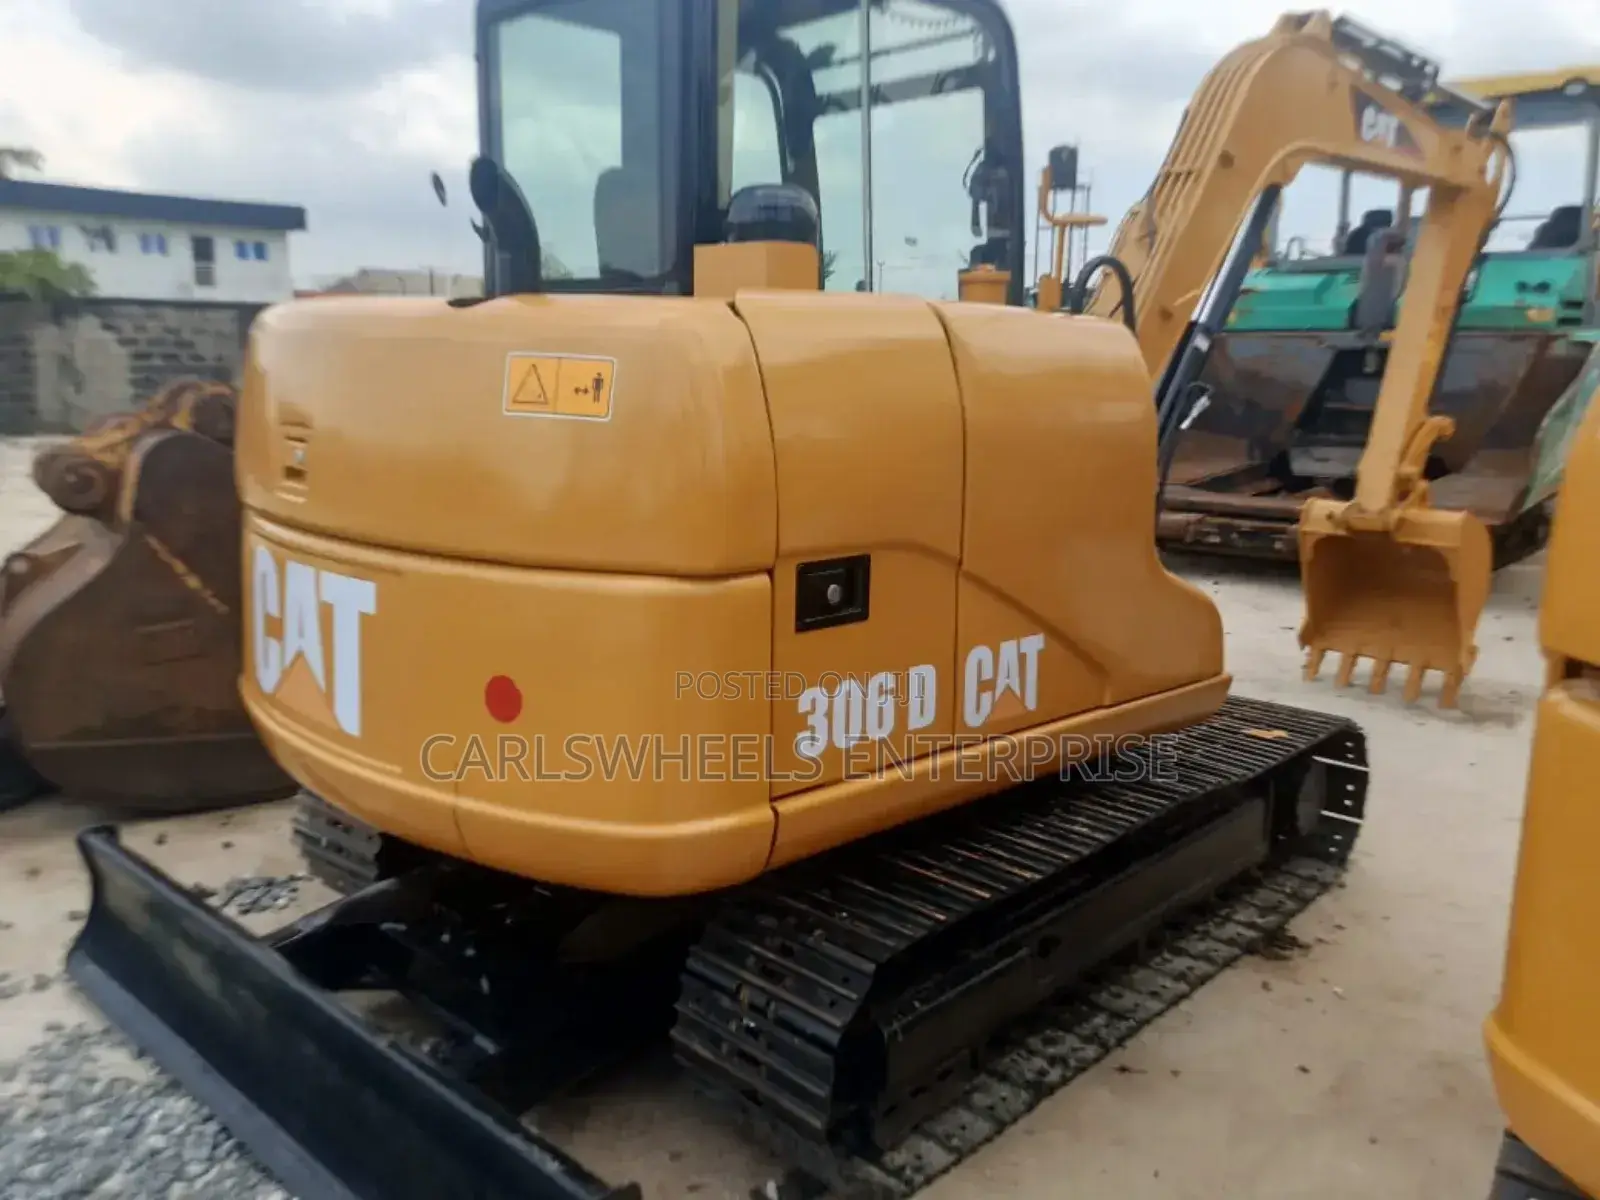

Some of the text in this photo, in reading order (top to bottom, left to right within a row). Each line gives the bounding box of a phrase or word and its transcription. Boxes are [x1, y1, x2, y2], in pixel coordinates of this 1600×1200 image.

[1361, 104, 1399, 148] CAT
[252, 545, 377, 737] CAT
[963, 632, 1045, 728] CAT
[796, 671, 895, 758] 306
